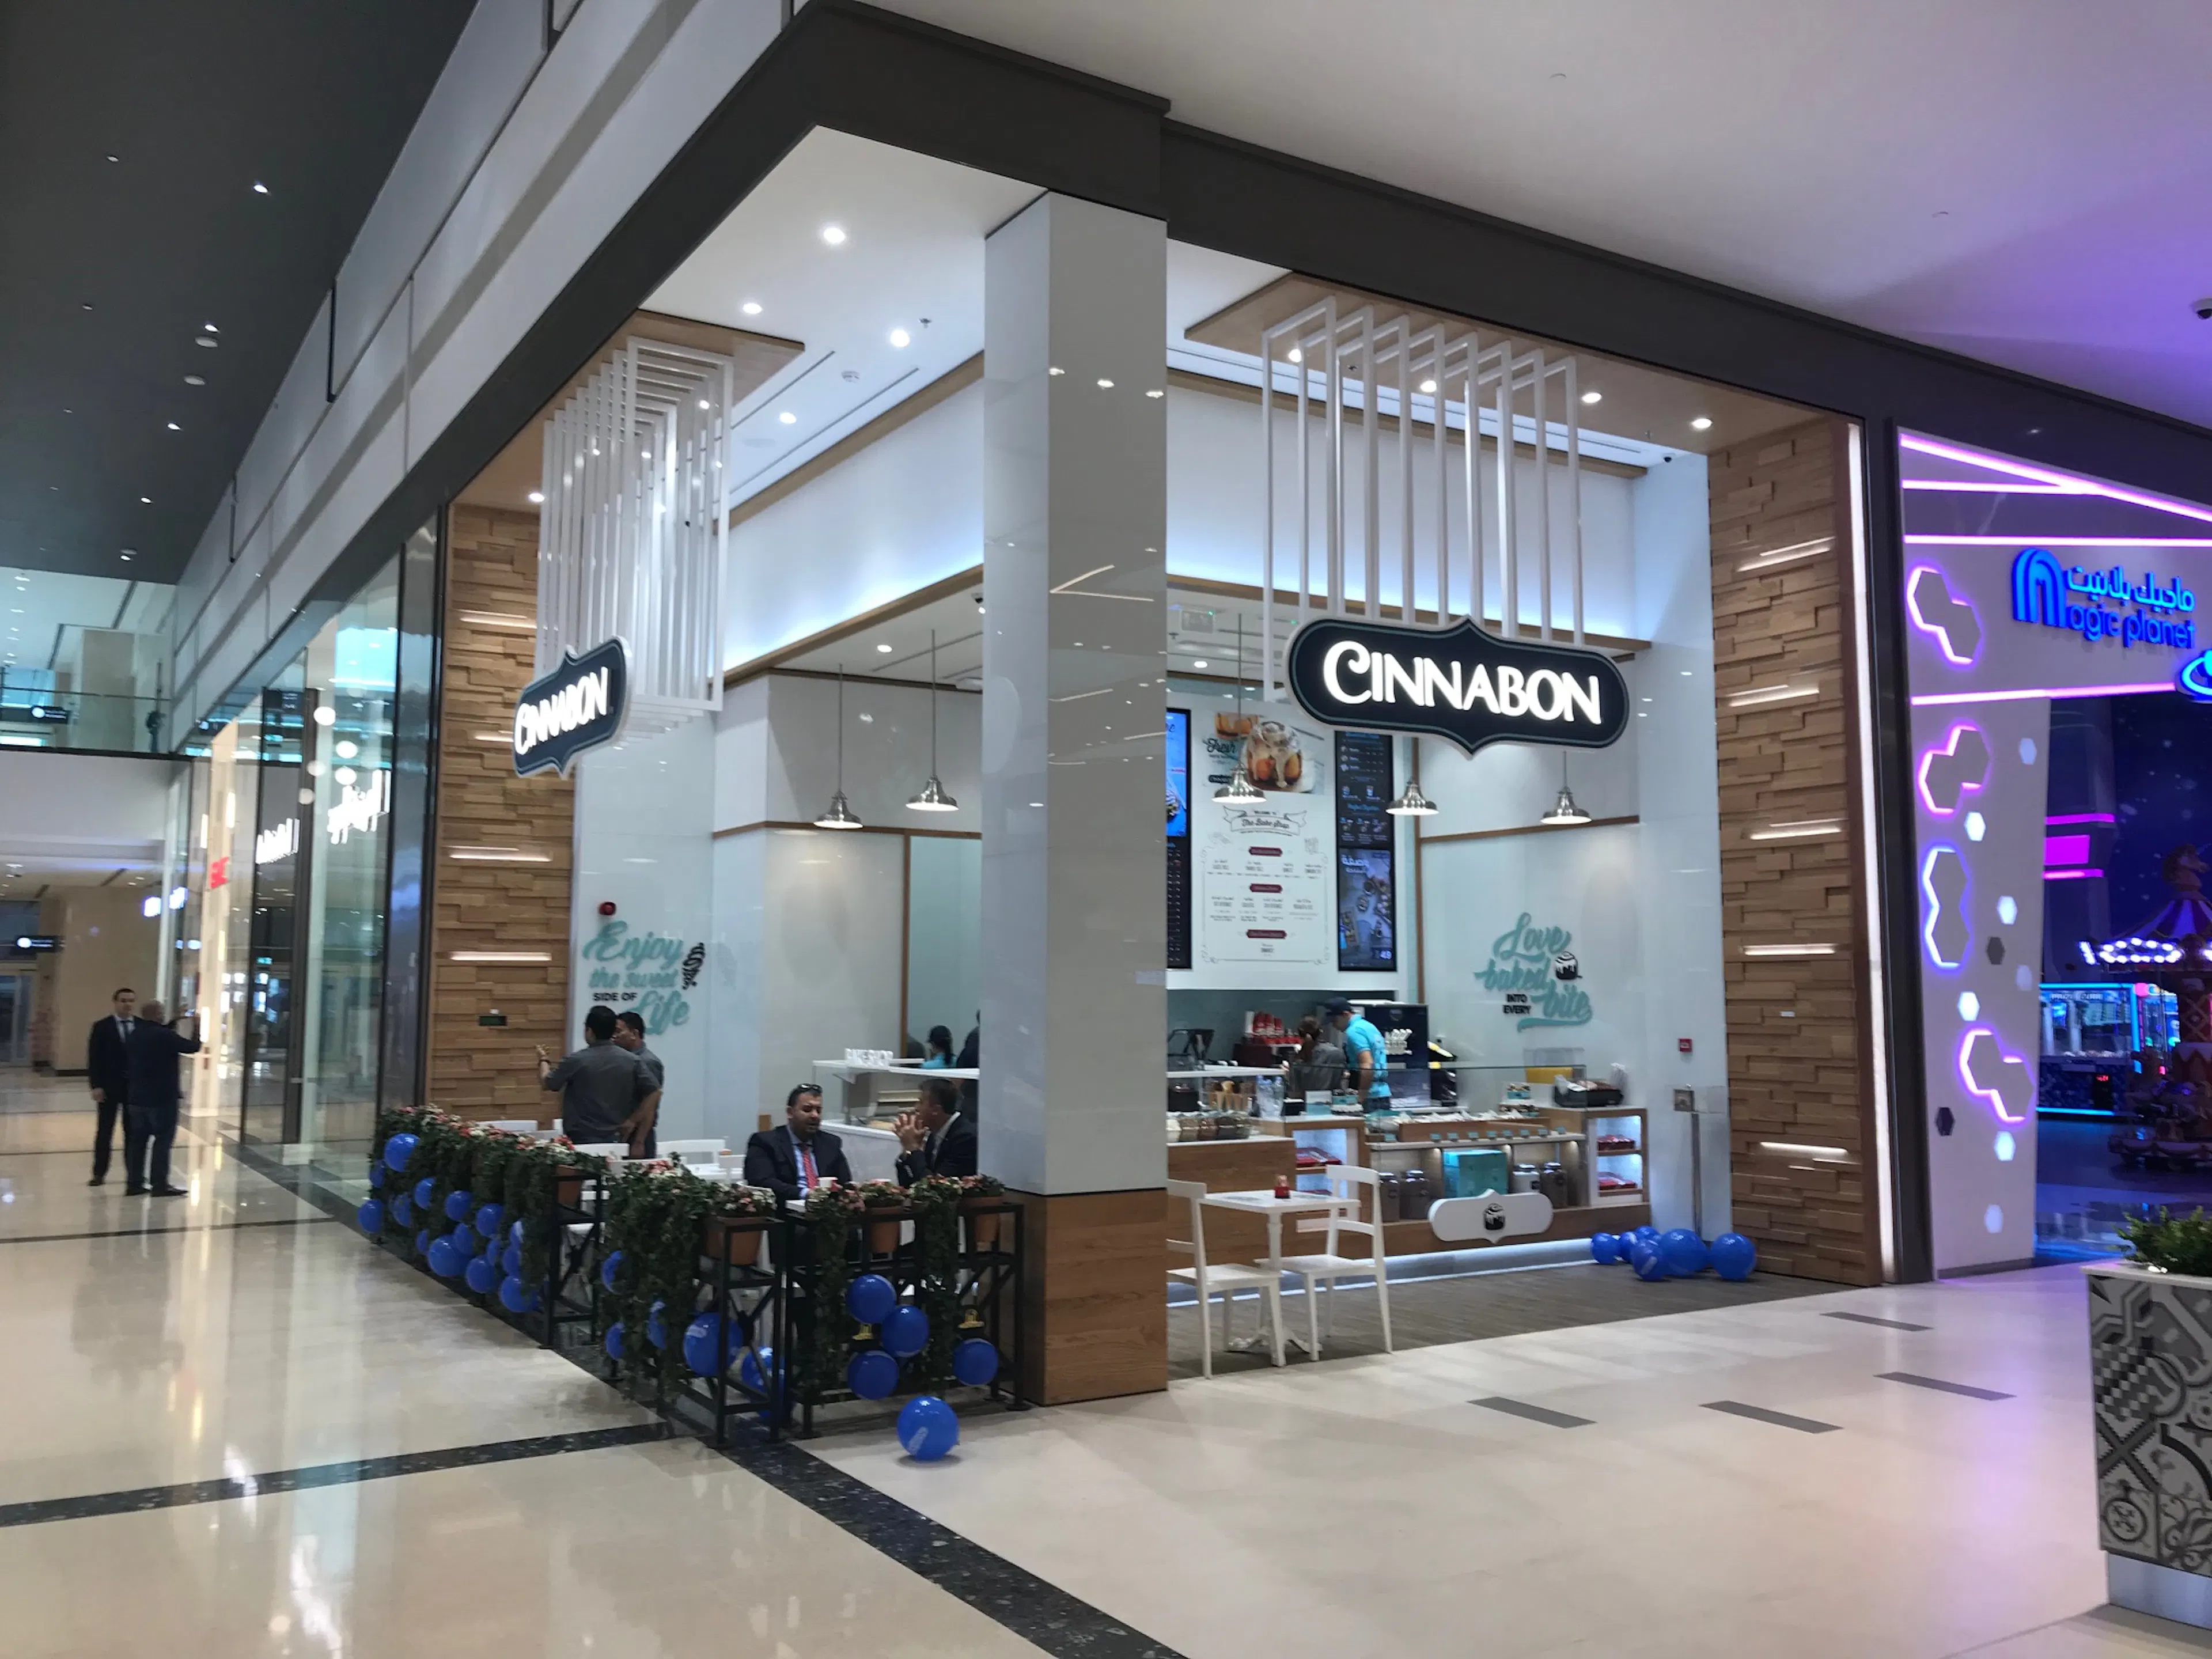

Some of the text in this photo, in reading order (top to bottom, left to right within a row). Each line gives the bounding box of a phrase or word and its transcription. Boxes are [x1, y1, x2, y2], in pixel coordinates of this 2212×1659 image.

[2064, 565, 2195, 613] ماجيك بلانيت
[2123, 608, 2195, 649] planet
[1323, 640, 1601, 725] CINNABON
[582, 921, 684, 970] Enjoy
[1493, 912, 1572, 963] Love
[1474, 958, 1551, 991] baked
[593, 993, 619, 1001] SIDE
[621, 993, 638, 1001] OF
[1503, 1005, 1532, 1014] EVERY
[1506, 994, 1528, 1003] INTO
